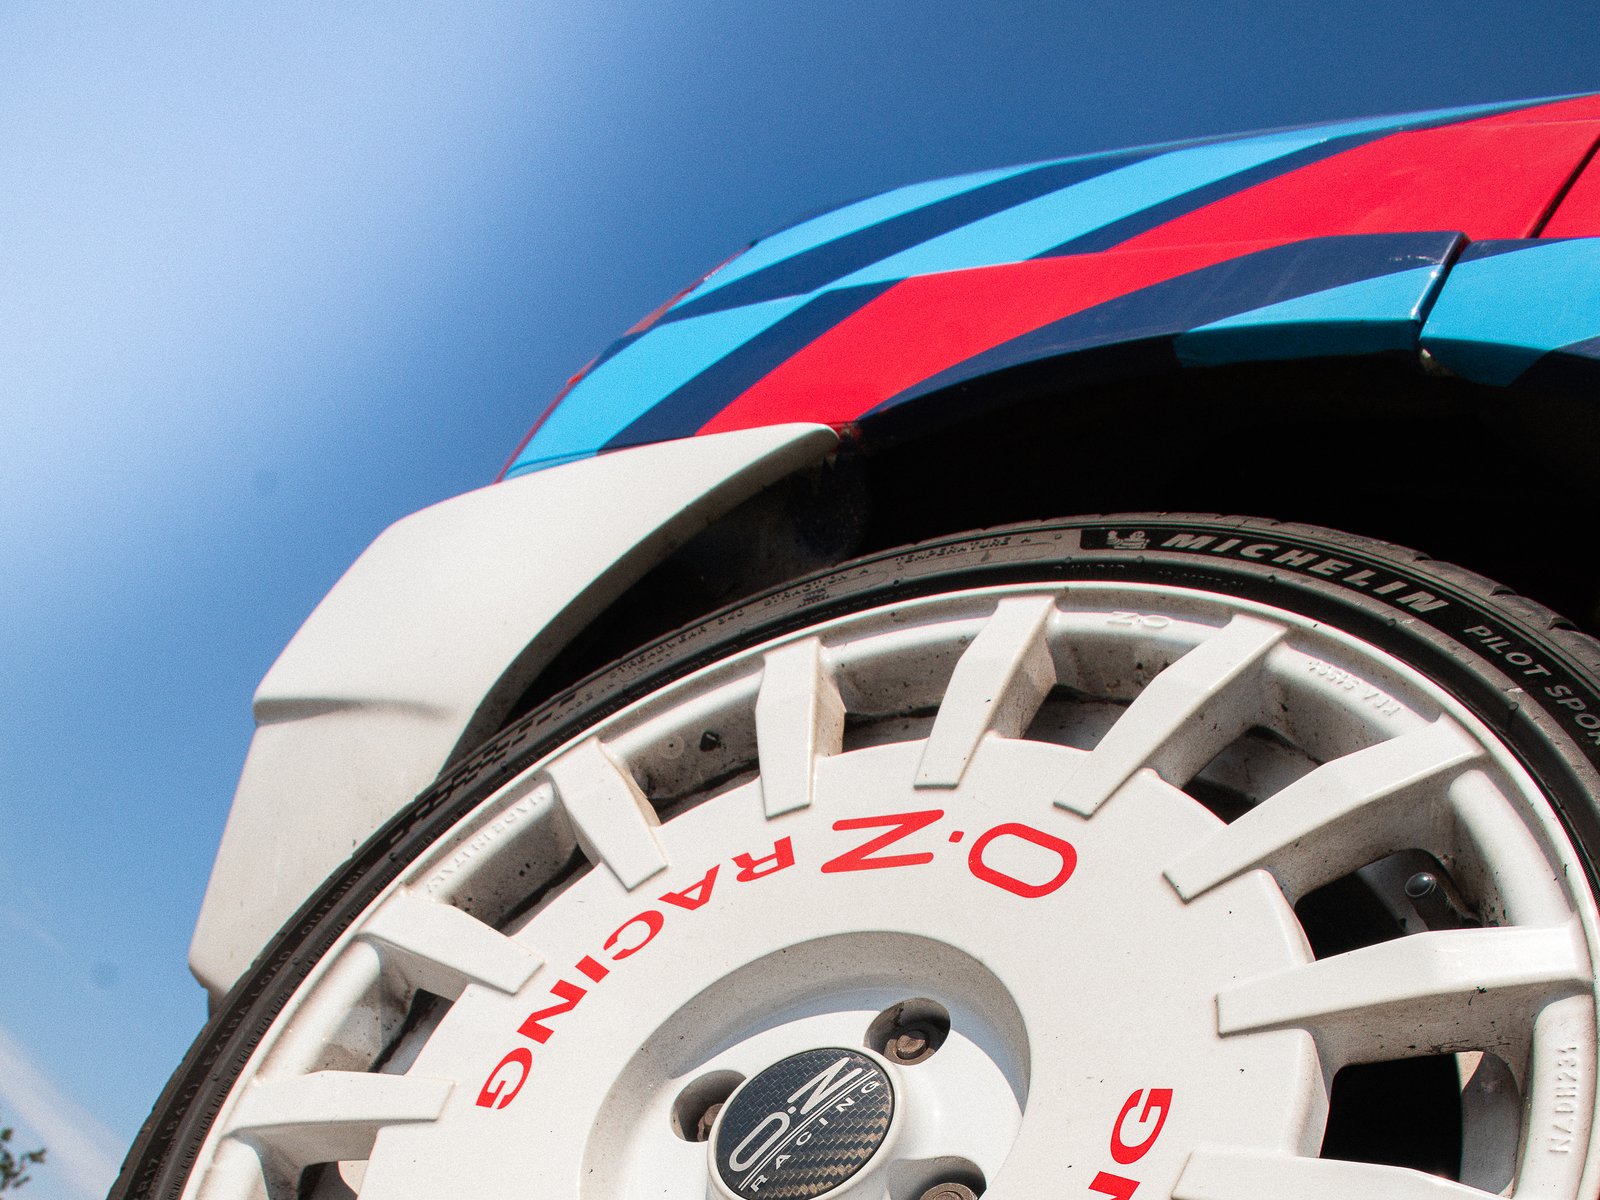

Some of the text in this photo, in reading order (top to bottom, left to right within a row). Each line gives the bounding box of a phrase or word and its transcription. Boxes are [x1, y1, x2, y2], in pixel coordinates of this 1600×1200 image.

[894, 536, 1012, 566] TEMPERATURE
[1160, 534, 1449, 612] MICHELIN
[1464, 625, 1551, 677] PILOT
[202, 1001, 251, 1069] EXTRA
[250, 947, 293, 999] LOAD
[299, 863, 370, 937] OUTSIDE
[476, 810, 1077, 1109] O.Z RACING
[729, 1057, 862, 1172] O.Z
[751, 1082, 880, 1193] RACING
